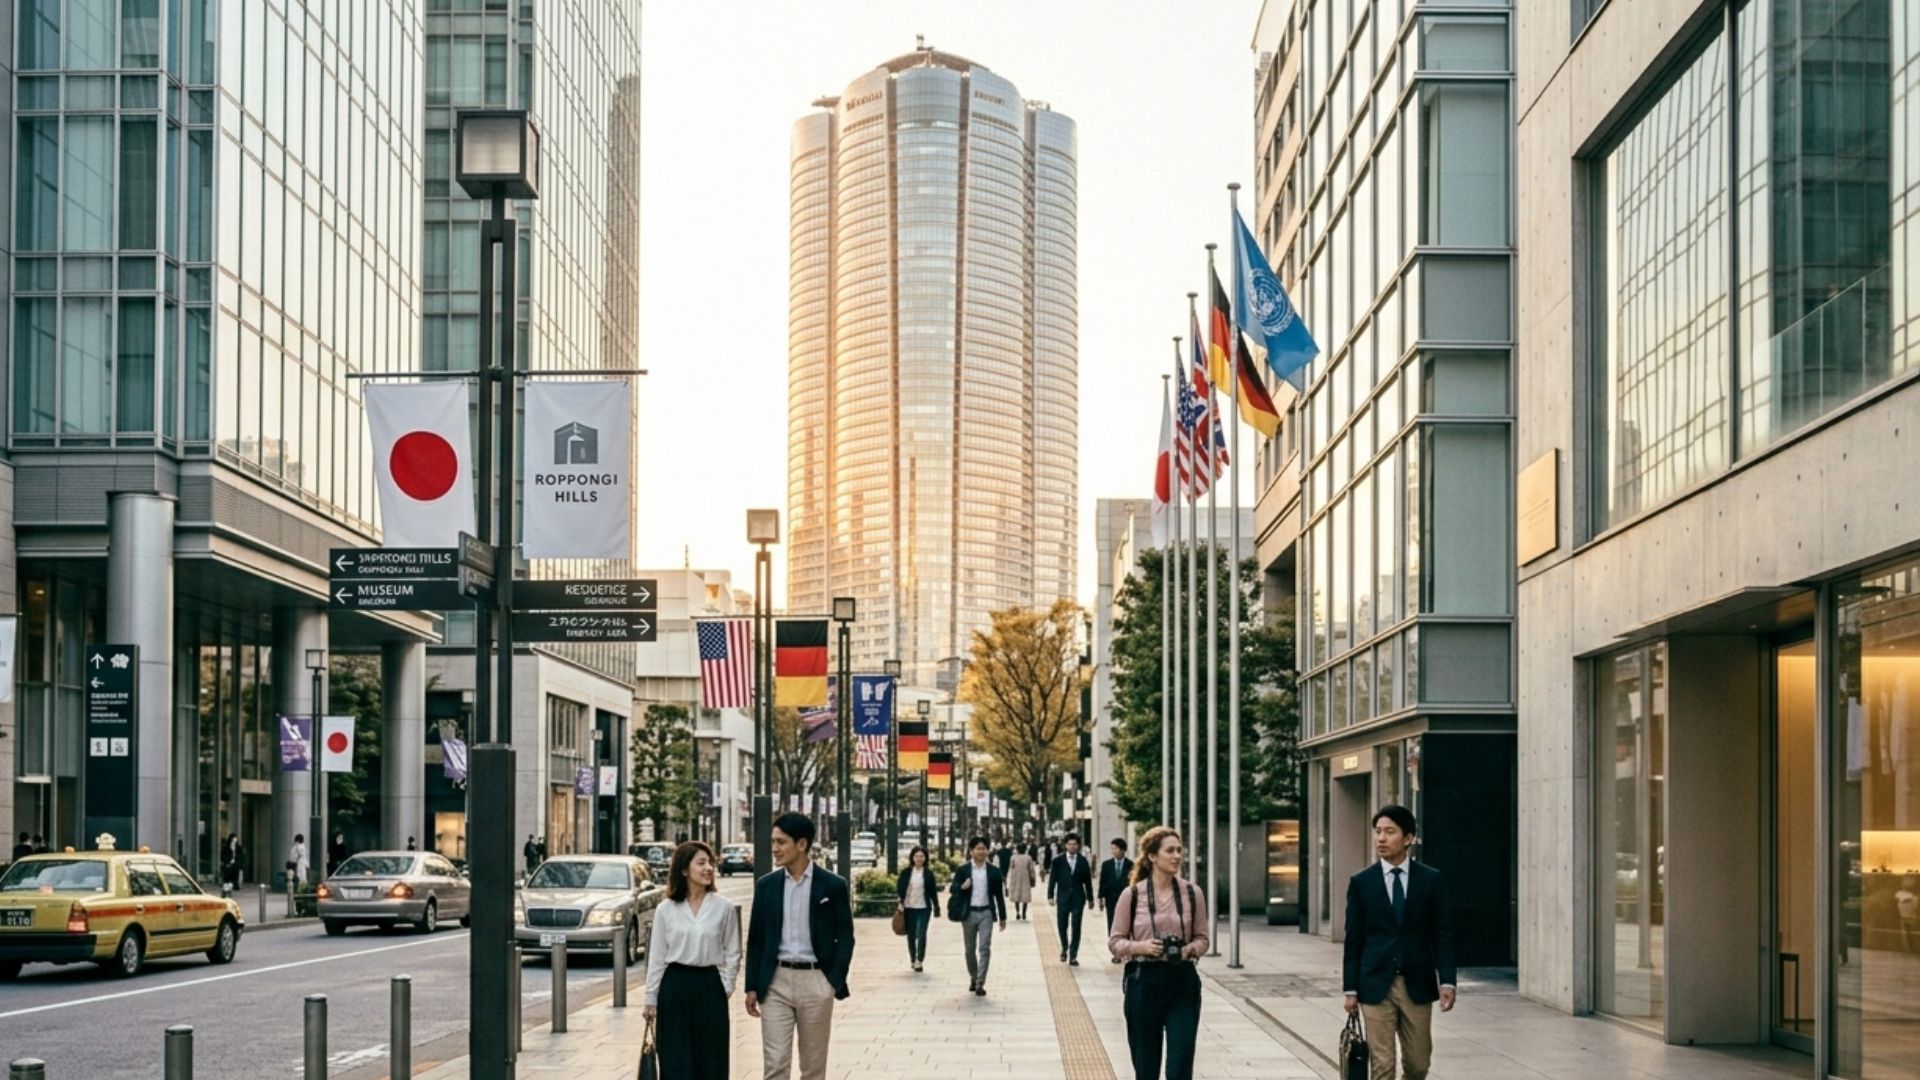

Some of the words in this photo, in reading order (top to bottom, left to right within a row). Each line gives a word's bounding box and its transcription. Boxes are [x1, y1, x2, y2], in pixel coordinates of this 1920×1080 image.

[535, 474, 618, 486] ROPPONGI
[555, 491, 598, 502] HILLS
[358, 585, 414, 596] MUSEUM
